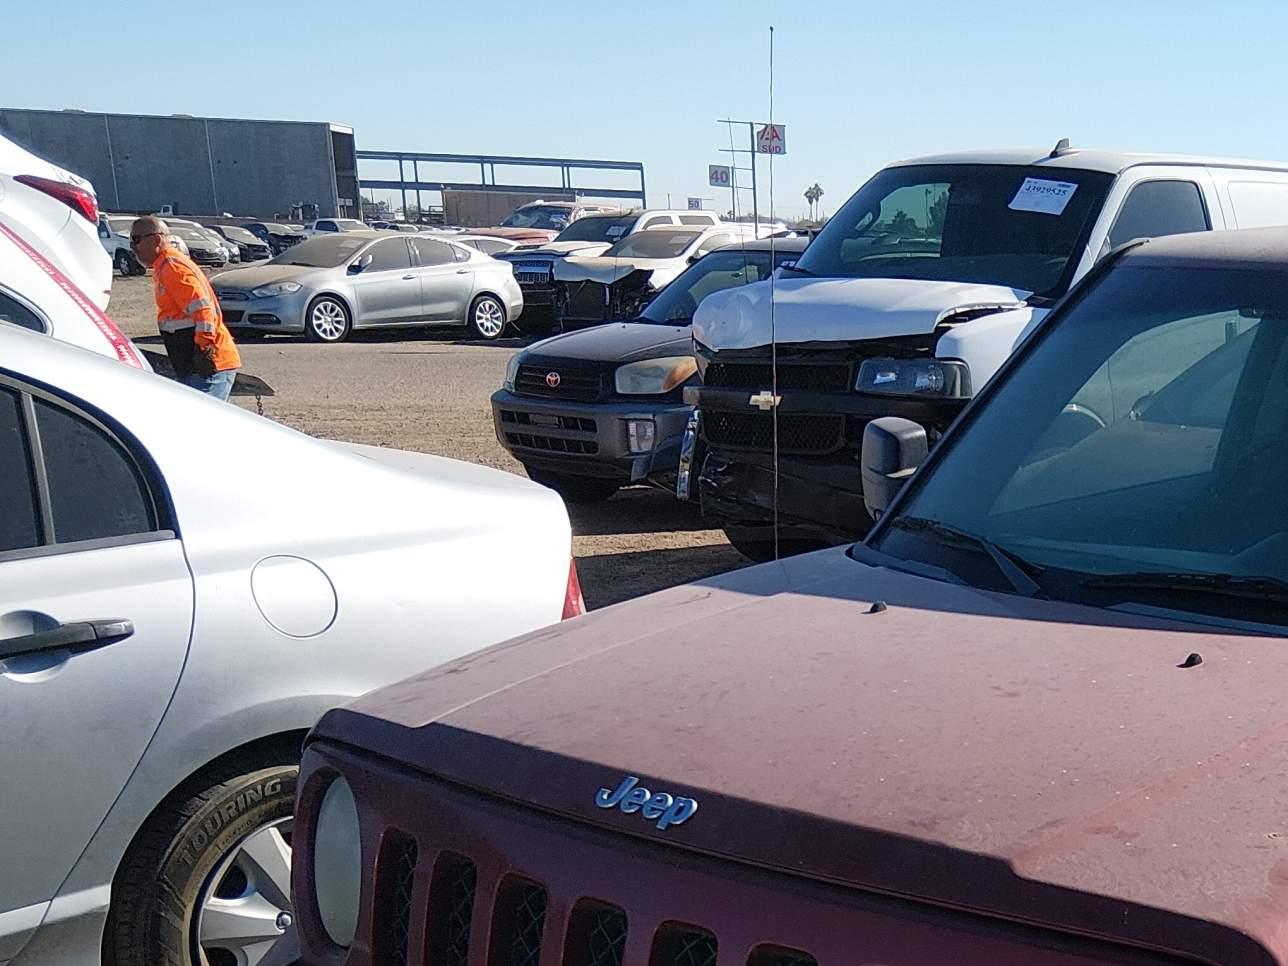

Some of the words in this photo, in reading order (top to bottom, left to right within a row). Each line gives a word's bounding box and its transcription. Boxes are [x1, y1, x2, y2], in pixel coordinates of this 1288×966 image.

[710, 170, 729, 183] 40
[181, 779, 281, 865] TOURING
[595, 775, 698, 830] Jeep
